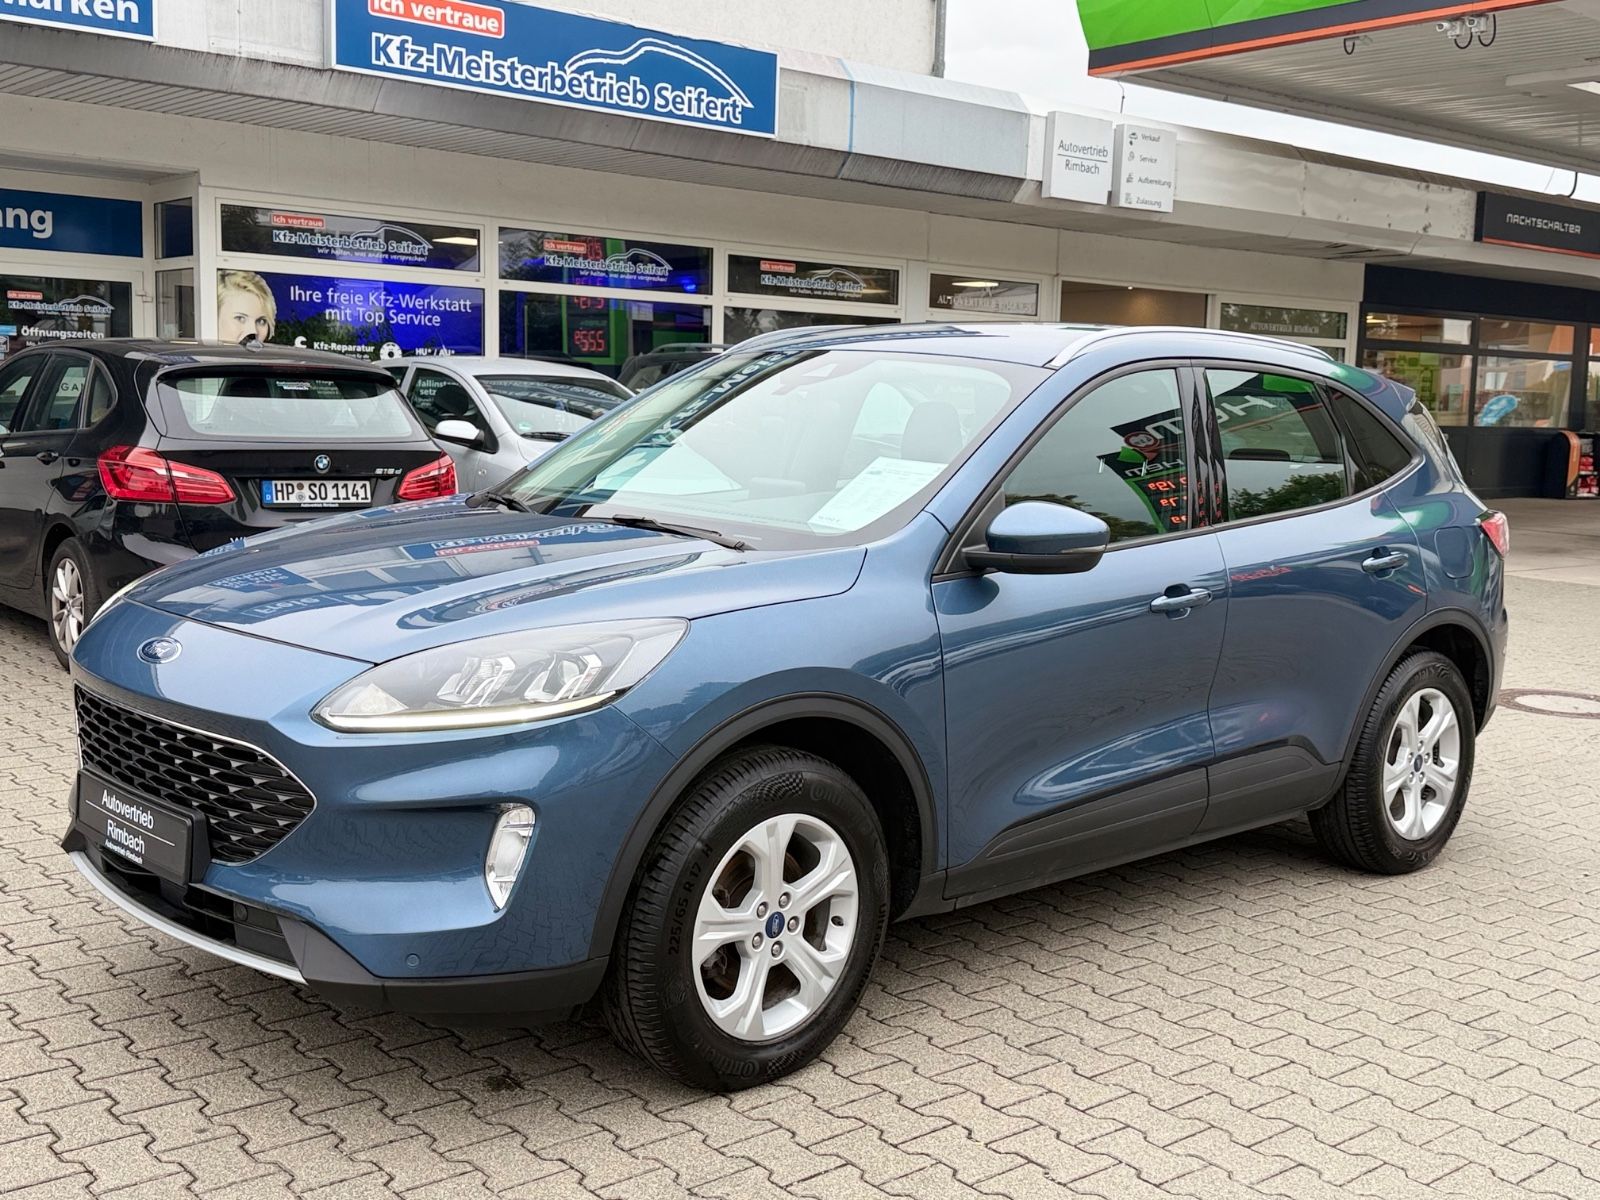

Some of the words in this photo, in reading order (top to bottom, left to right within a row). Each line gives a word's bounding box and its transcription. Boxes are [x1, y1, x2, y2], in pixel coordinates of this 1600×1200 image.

[412, 2, 499, 33] vertraue
[371, 32, 650, 109] Kfz-Meisterbetrieb
[654, 82, 742, 124] Seifert
[1141, 133, 1161, 142] Verkauf
[1058, 140, 1109, 158] Autovertrieb
[1139, 154, 1158, 164] Service
[1064, 159, 1100, 175] Rimbach
[1135, 196, 1162, 209] Zulassung
[0, 207, 53, 239] ng
[273, 215, 286, 224] Ich
[287, 217, 323, 227] vertraue
[1506, 213, 1582, 235] NACHTSCHALTER
[272, 229, 387, 252] Kfz-Meisterbetrieb
[388, 240, 429, 256] Seifert
[543, 254, 636, 272] Kfz-Meisterbetrieb
[636, 262, 669, 276] Seifert
[290, 286, 322, 303] Ihre
[326, 288, 364, 306] freie
[368, 292, 472, 313] Kfz-Werkstatt
[325, 307, 352, 322] mit
[356, 307, 385, 326] Top
[389, 311, 441, 327] Service
[21, 325, 104, 340] Öffnungszeiten
[313, 341, 375, 353] Kfz-Reparatur
[274, 482, 295, 501] HP
[308, 482, 329, 501] SO
[331, 483, 369, 501] 1141
[102, 789, 154, 829] Autovertrieb
[107, 819, 145, 854] Rimbach
[668, 897, 688, 955] 225/65
